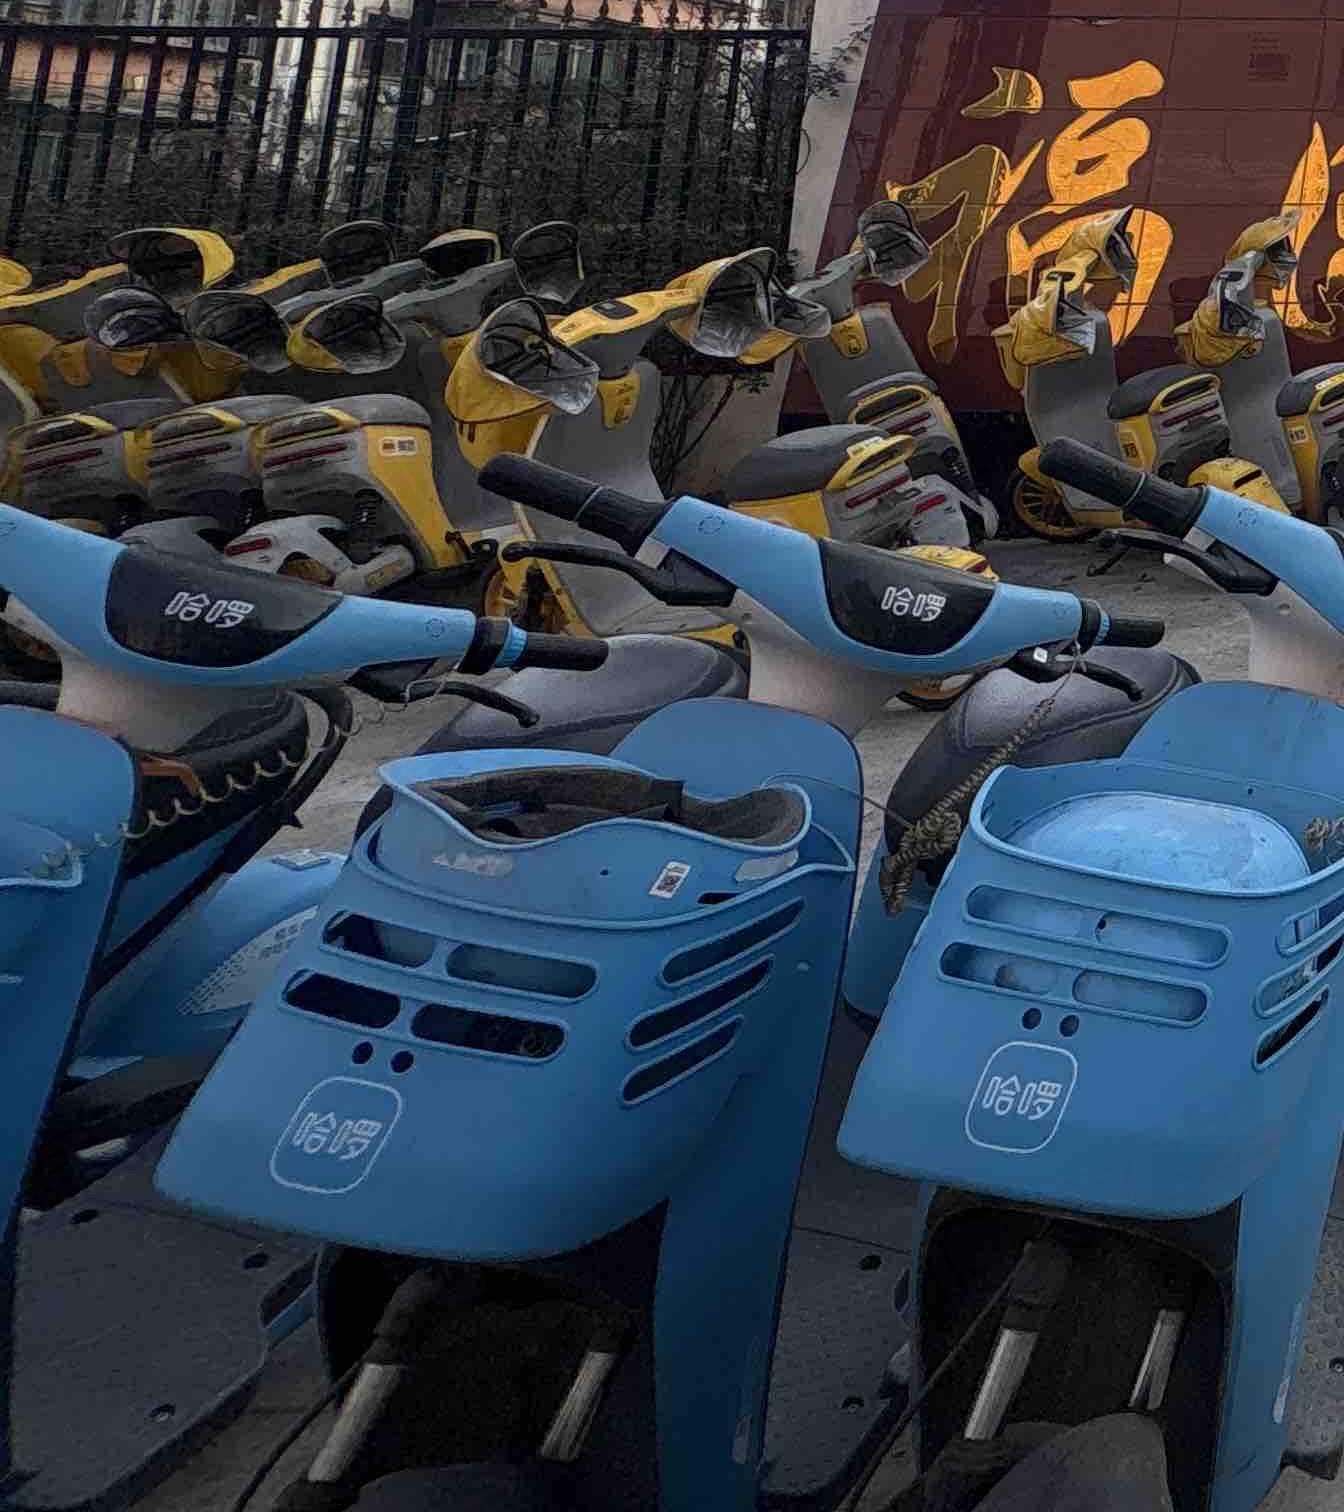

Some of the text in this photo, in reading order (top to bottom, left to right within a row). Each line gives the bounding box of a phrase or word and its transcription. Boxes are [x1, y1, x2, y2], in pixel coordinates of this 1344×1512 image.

[164, 591, 255, 628] 哈啰
[880, 586, 947, 622] 哈啰
[982, 1074, 1062, 1120] 哈啰
[292, 1111, 382, 1160] 哈啰
